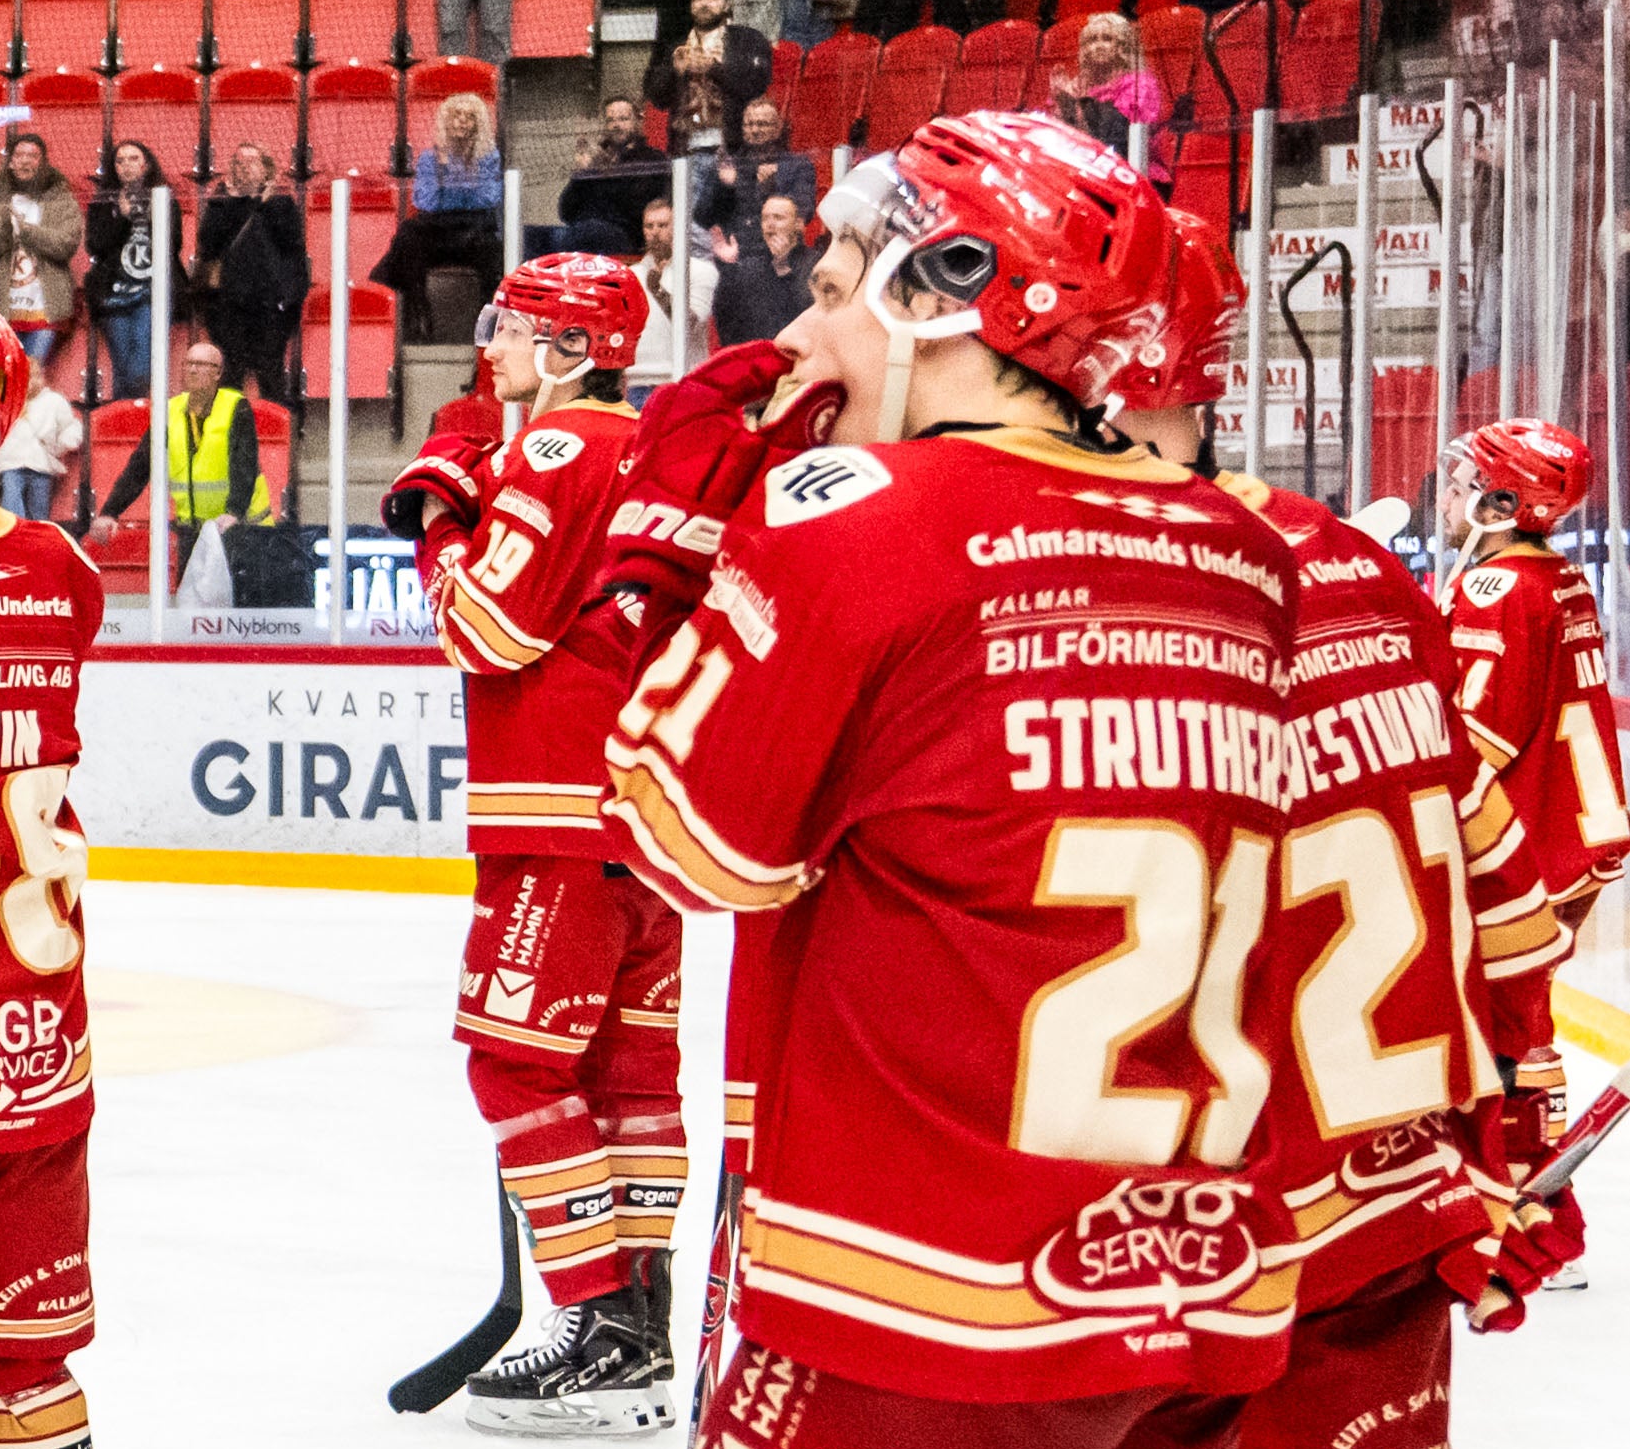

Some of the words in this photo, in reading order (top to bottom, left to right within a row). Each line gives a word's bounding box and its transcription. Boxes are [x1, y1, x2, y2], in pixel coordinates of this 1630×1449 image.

[471, 519, 535, 595] 19
[966, 525, 1188, 568] Calmarsunds
[1192, 543, 1285, 607] Undertak
[225, 614, 302, 638] Nybloms
[979, 586, 1092, 621] KALMAR
[50, 666, 72, 688] AB
[986, 623, 1266, 684] BILFÖRMEDLING
[498, 873, 537, 963] KALMAR
[514, 904, 546, 967] HAMN
[1010, 817, 1275, 1169] 21
[53, 1251, 84, 1271] SON
